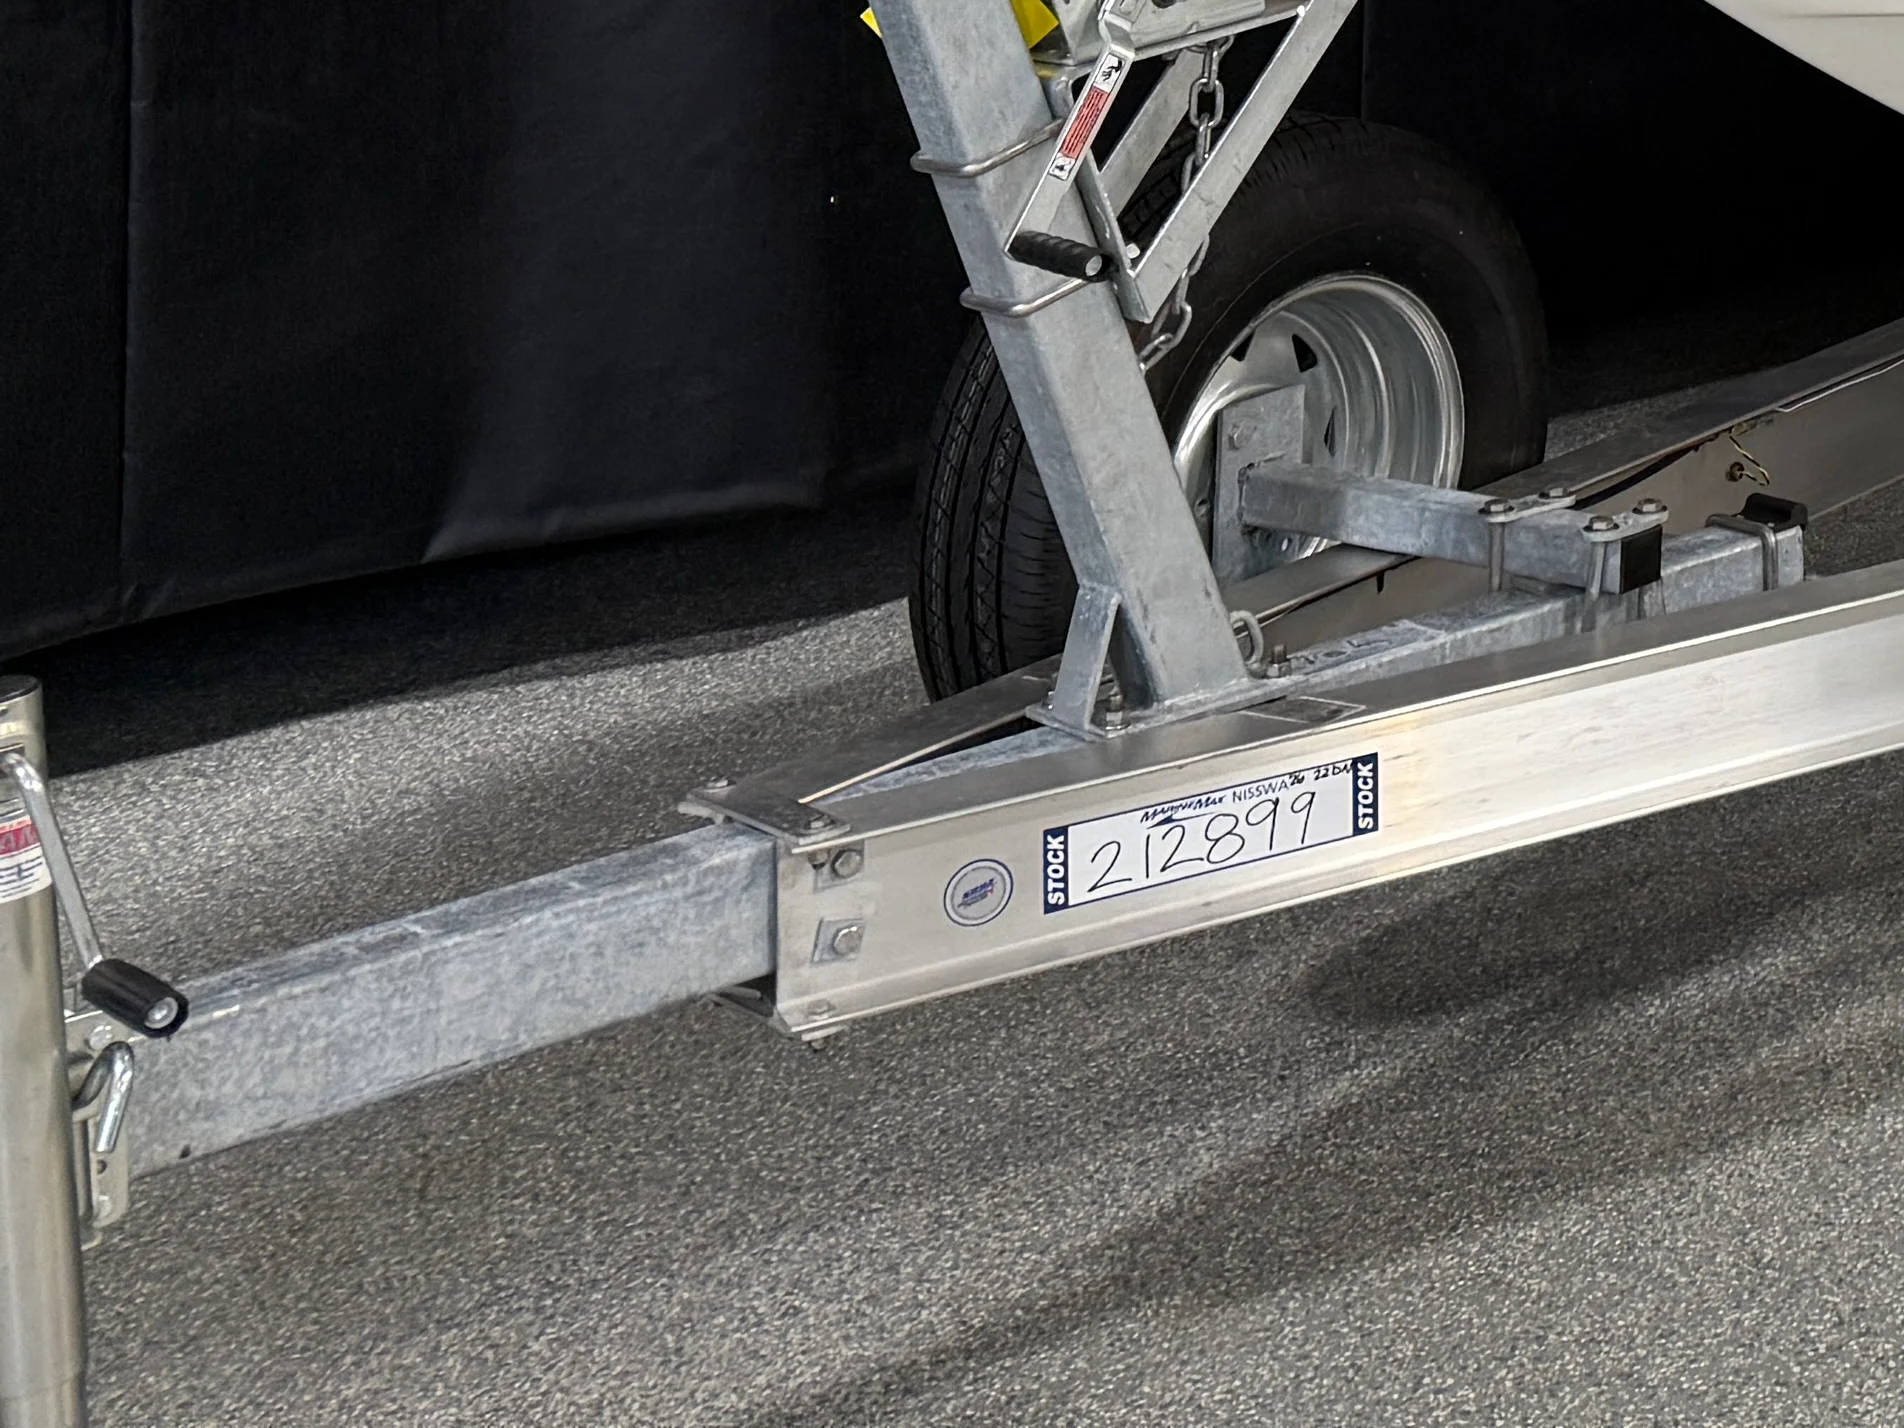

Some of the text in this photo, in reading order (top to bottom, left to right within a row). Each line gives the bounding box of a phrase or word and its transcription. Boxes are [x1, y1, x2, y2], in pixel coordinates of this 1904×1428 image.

[1232, 778, 1290, 804] NISSWA
[1358, 761, 1374, 830] STOCK
[1047, 834, 1066, 906] STOCK
[1087, 790, 1317, 893] 212899
